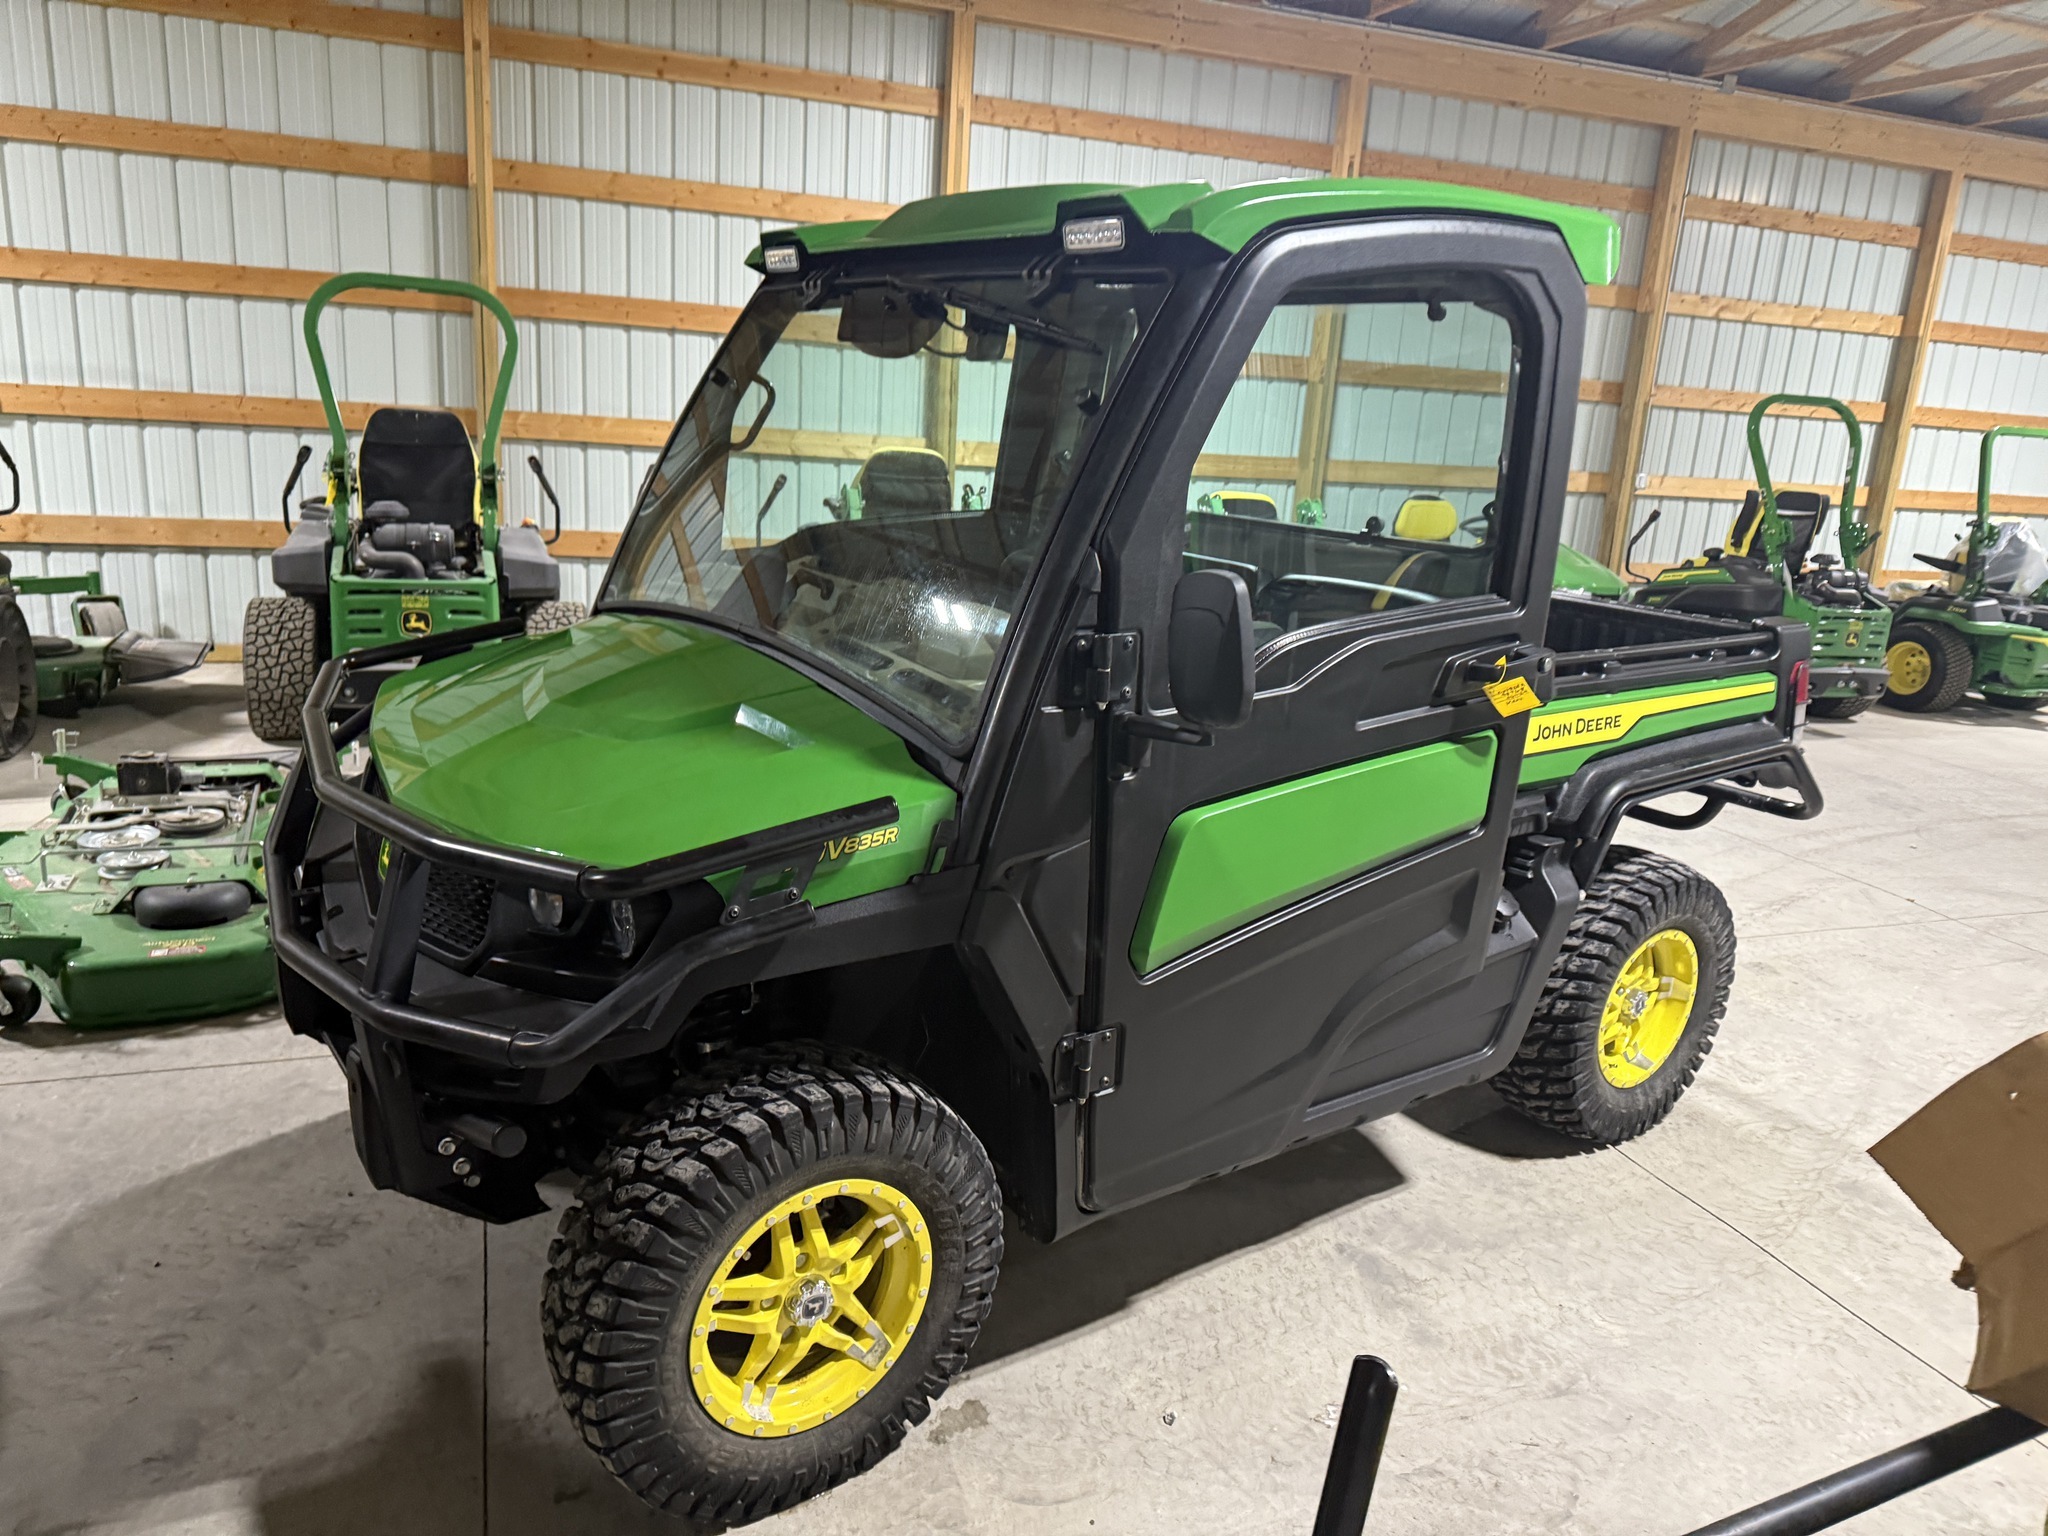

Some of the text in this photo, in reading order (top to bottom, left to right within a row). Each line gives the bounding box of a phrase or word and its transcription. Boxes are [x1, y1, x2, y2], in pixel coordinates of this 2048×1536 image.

[1532, 715, 1622, 742] JOHN DEERE
[818, 827, 899, 862] V835R
